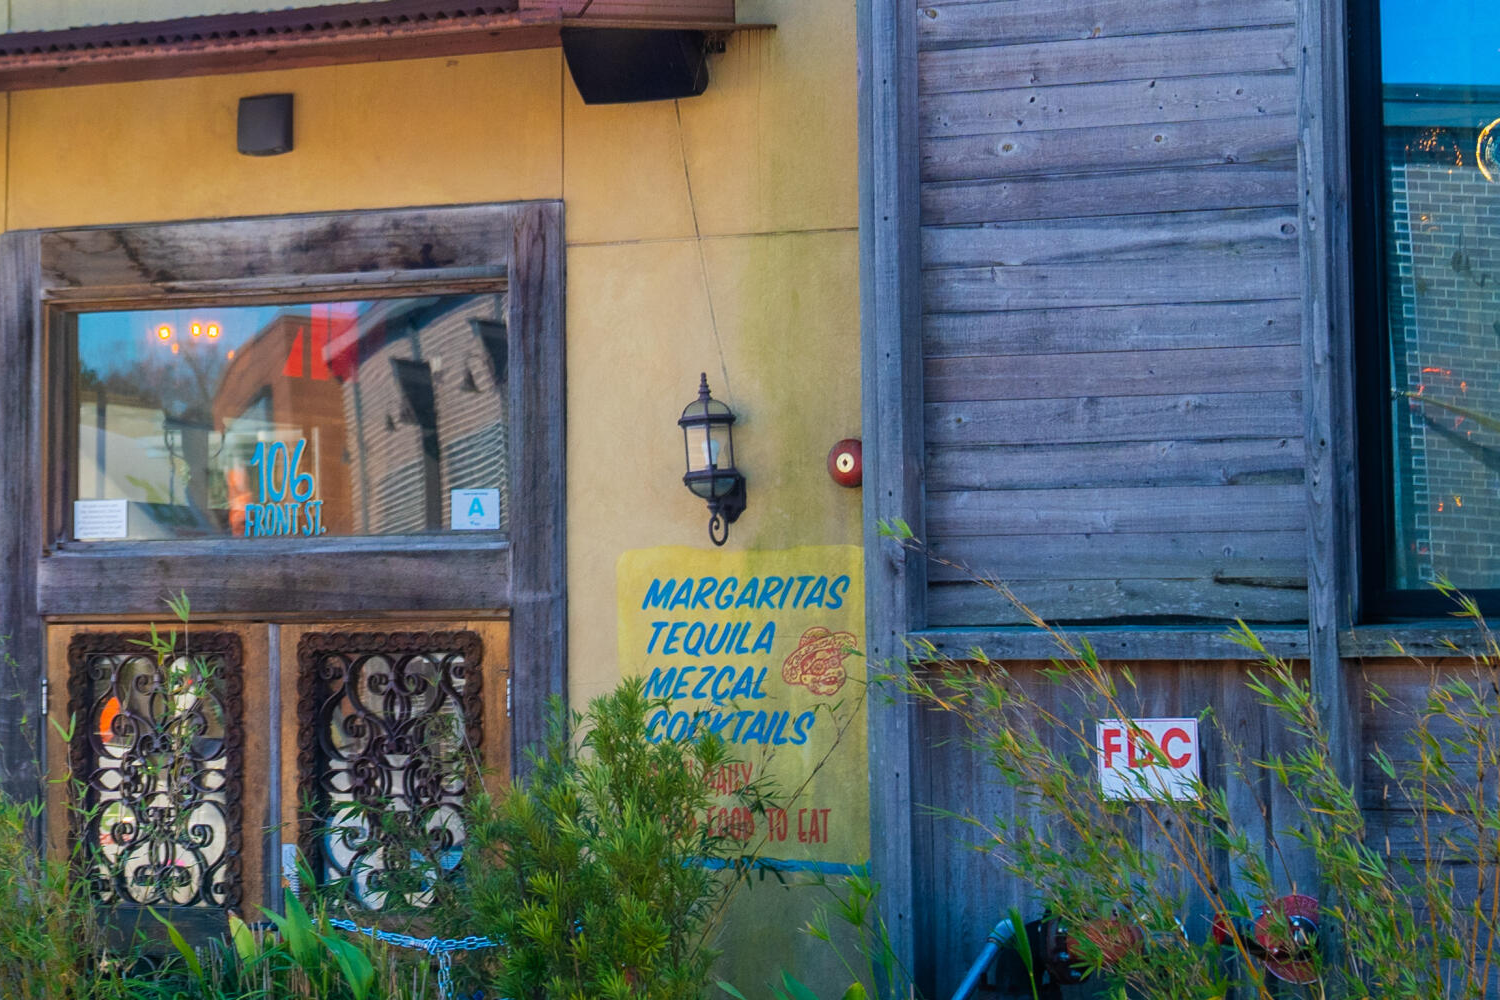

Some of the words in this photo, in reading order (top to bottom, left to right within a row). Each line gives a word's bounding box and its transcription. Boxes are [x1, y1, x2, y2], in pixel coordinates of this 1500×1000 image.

[249, 438, 315, 503] 106
[244, 503, 300, 537] FRONT
[302, 500, 327, 536] ST.
[467, 497, 485, 517] A
[641, 574, 851, 612] MARGARITAS
[646, 620, 776, 657] TEQUILA
[1102, 727, 1192, 769] FDC
[765, 807, 789, 842] TO
[797, 807, 832, 844] EAT
